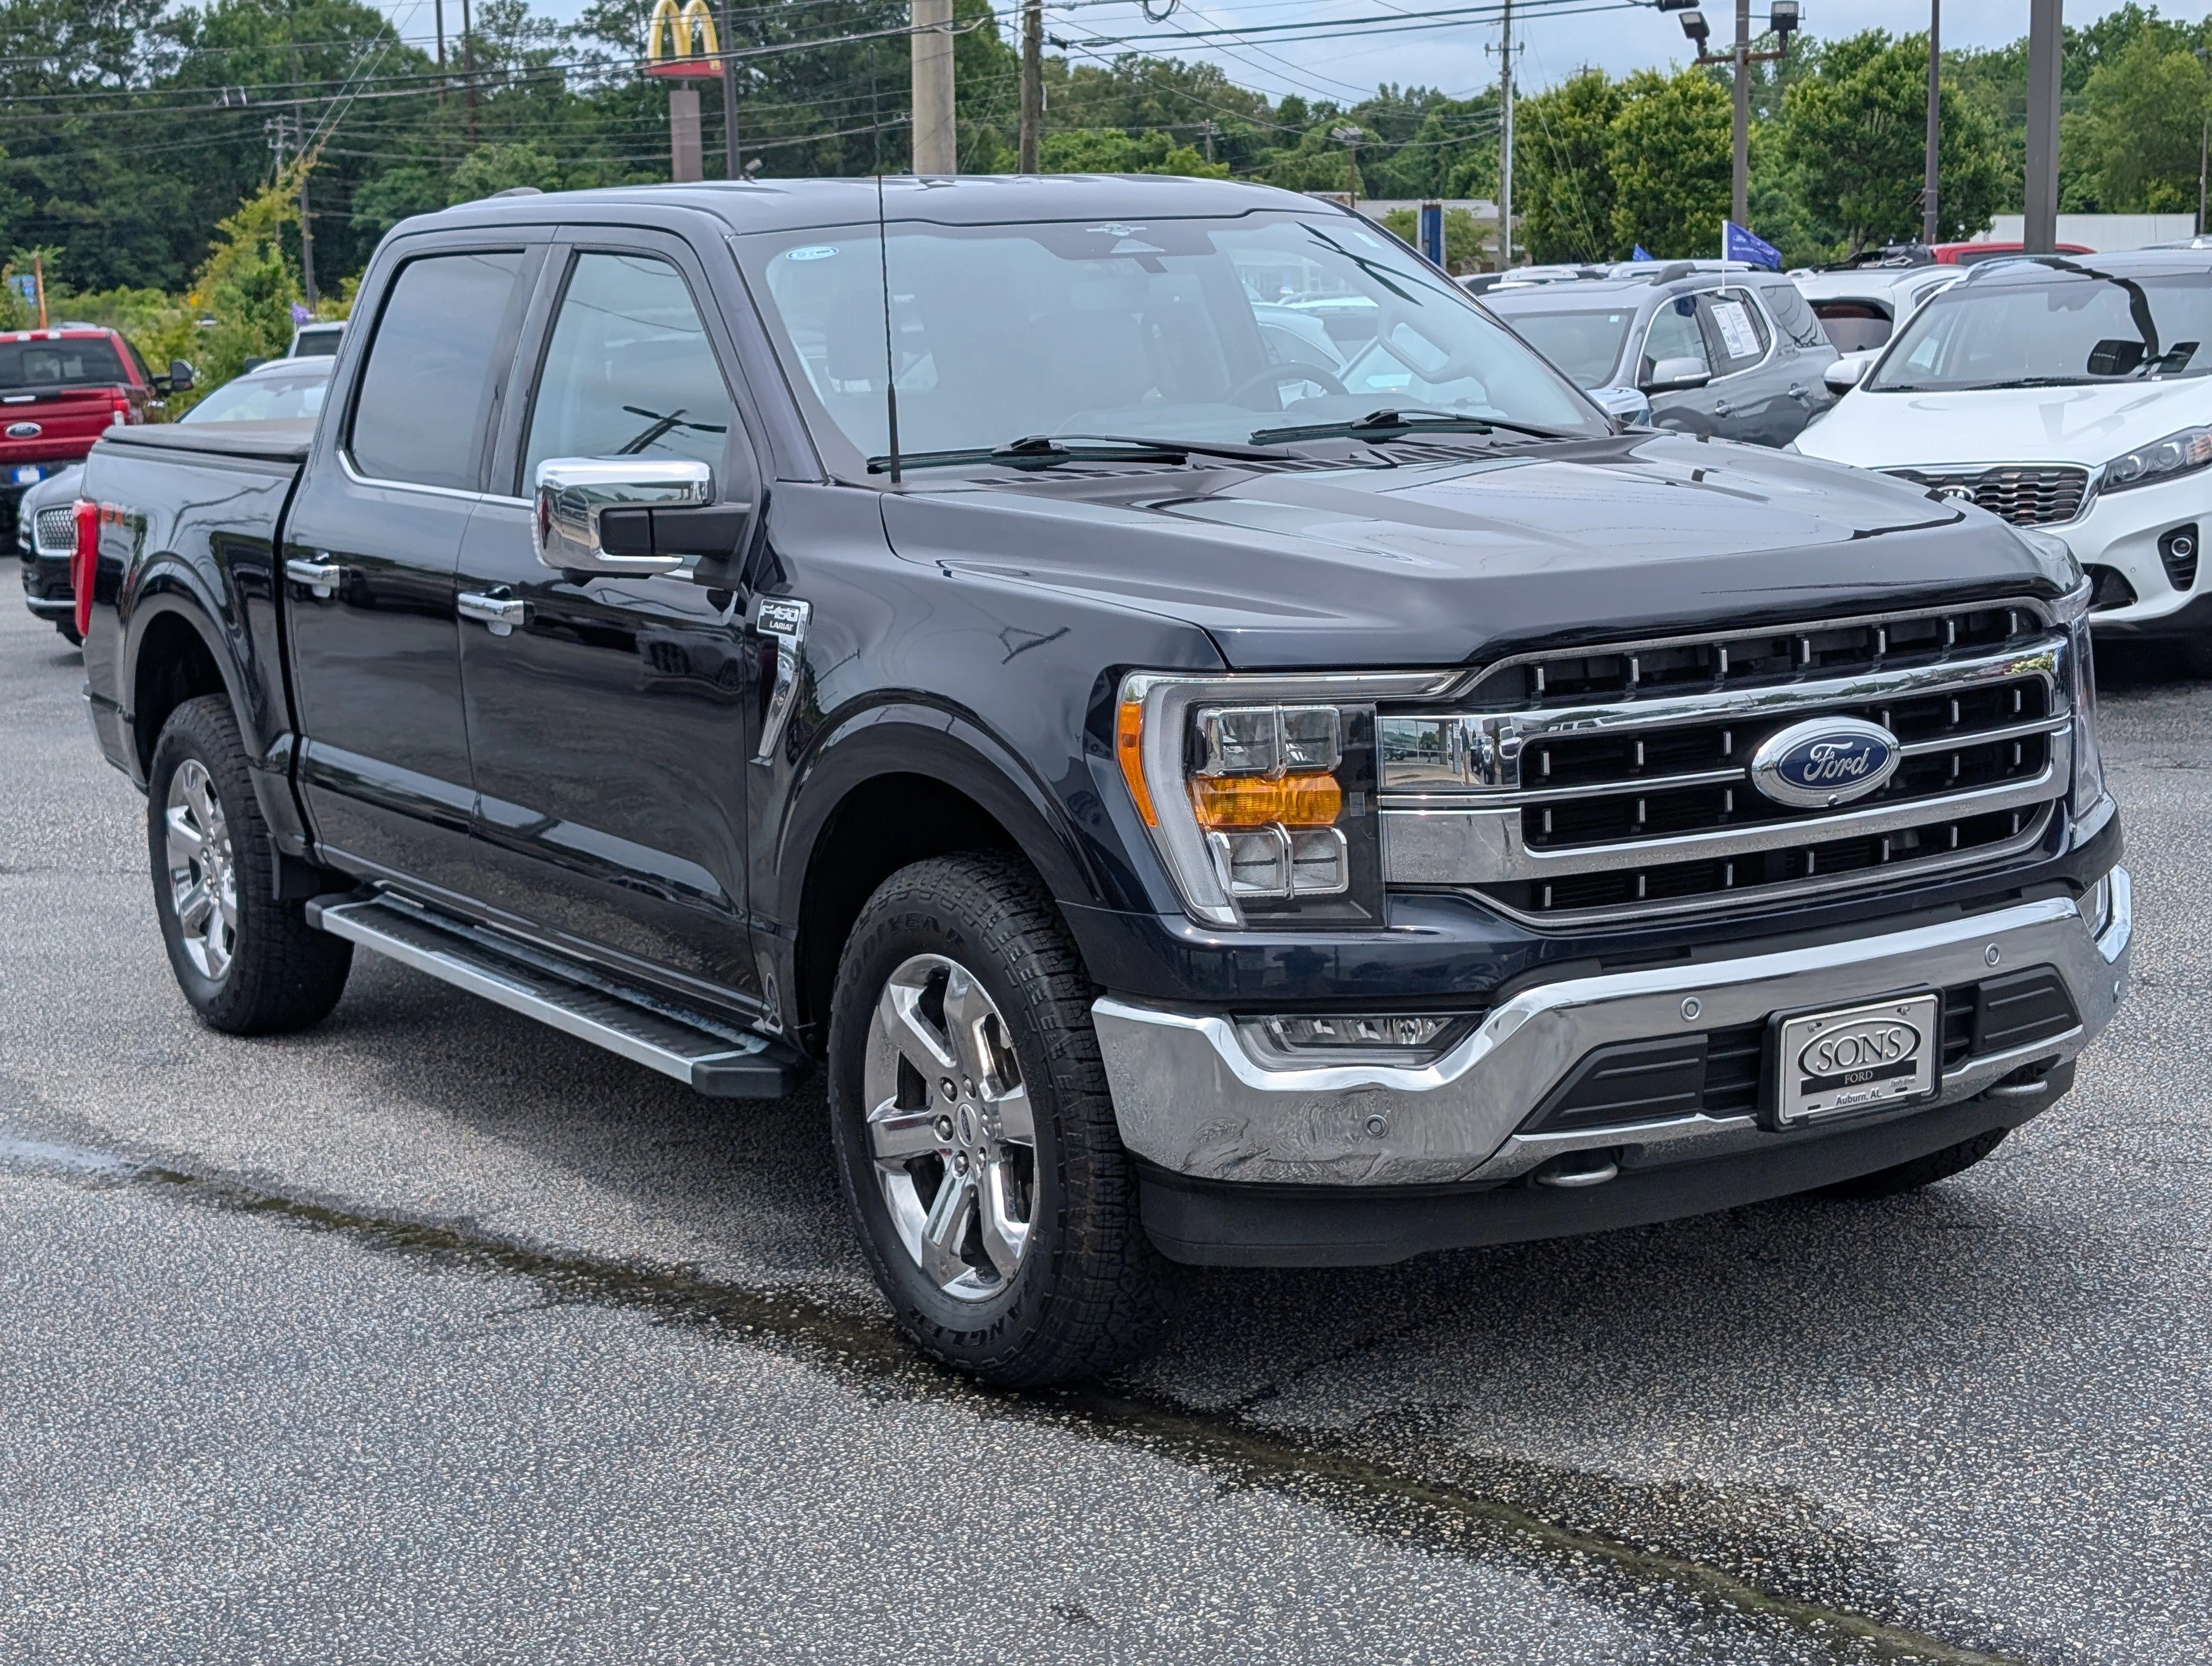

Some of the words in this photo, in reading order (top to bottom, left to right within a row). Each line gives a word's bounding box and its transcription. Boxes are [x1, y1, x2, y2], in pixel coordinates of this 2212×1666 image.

[760, 604, 799, 622] F-150
[769, 620, 794, 631] LARIAT
[1803, 741, 1870, 781] Ford
[1816, 1027, 1901, 1071] SONS
[1844, 1070, 1873, 1085] FORD
[1870, 1087, 1882, 1099] AL
